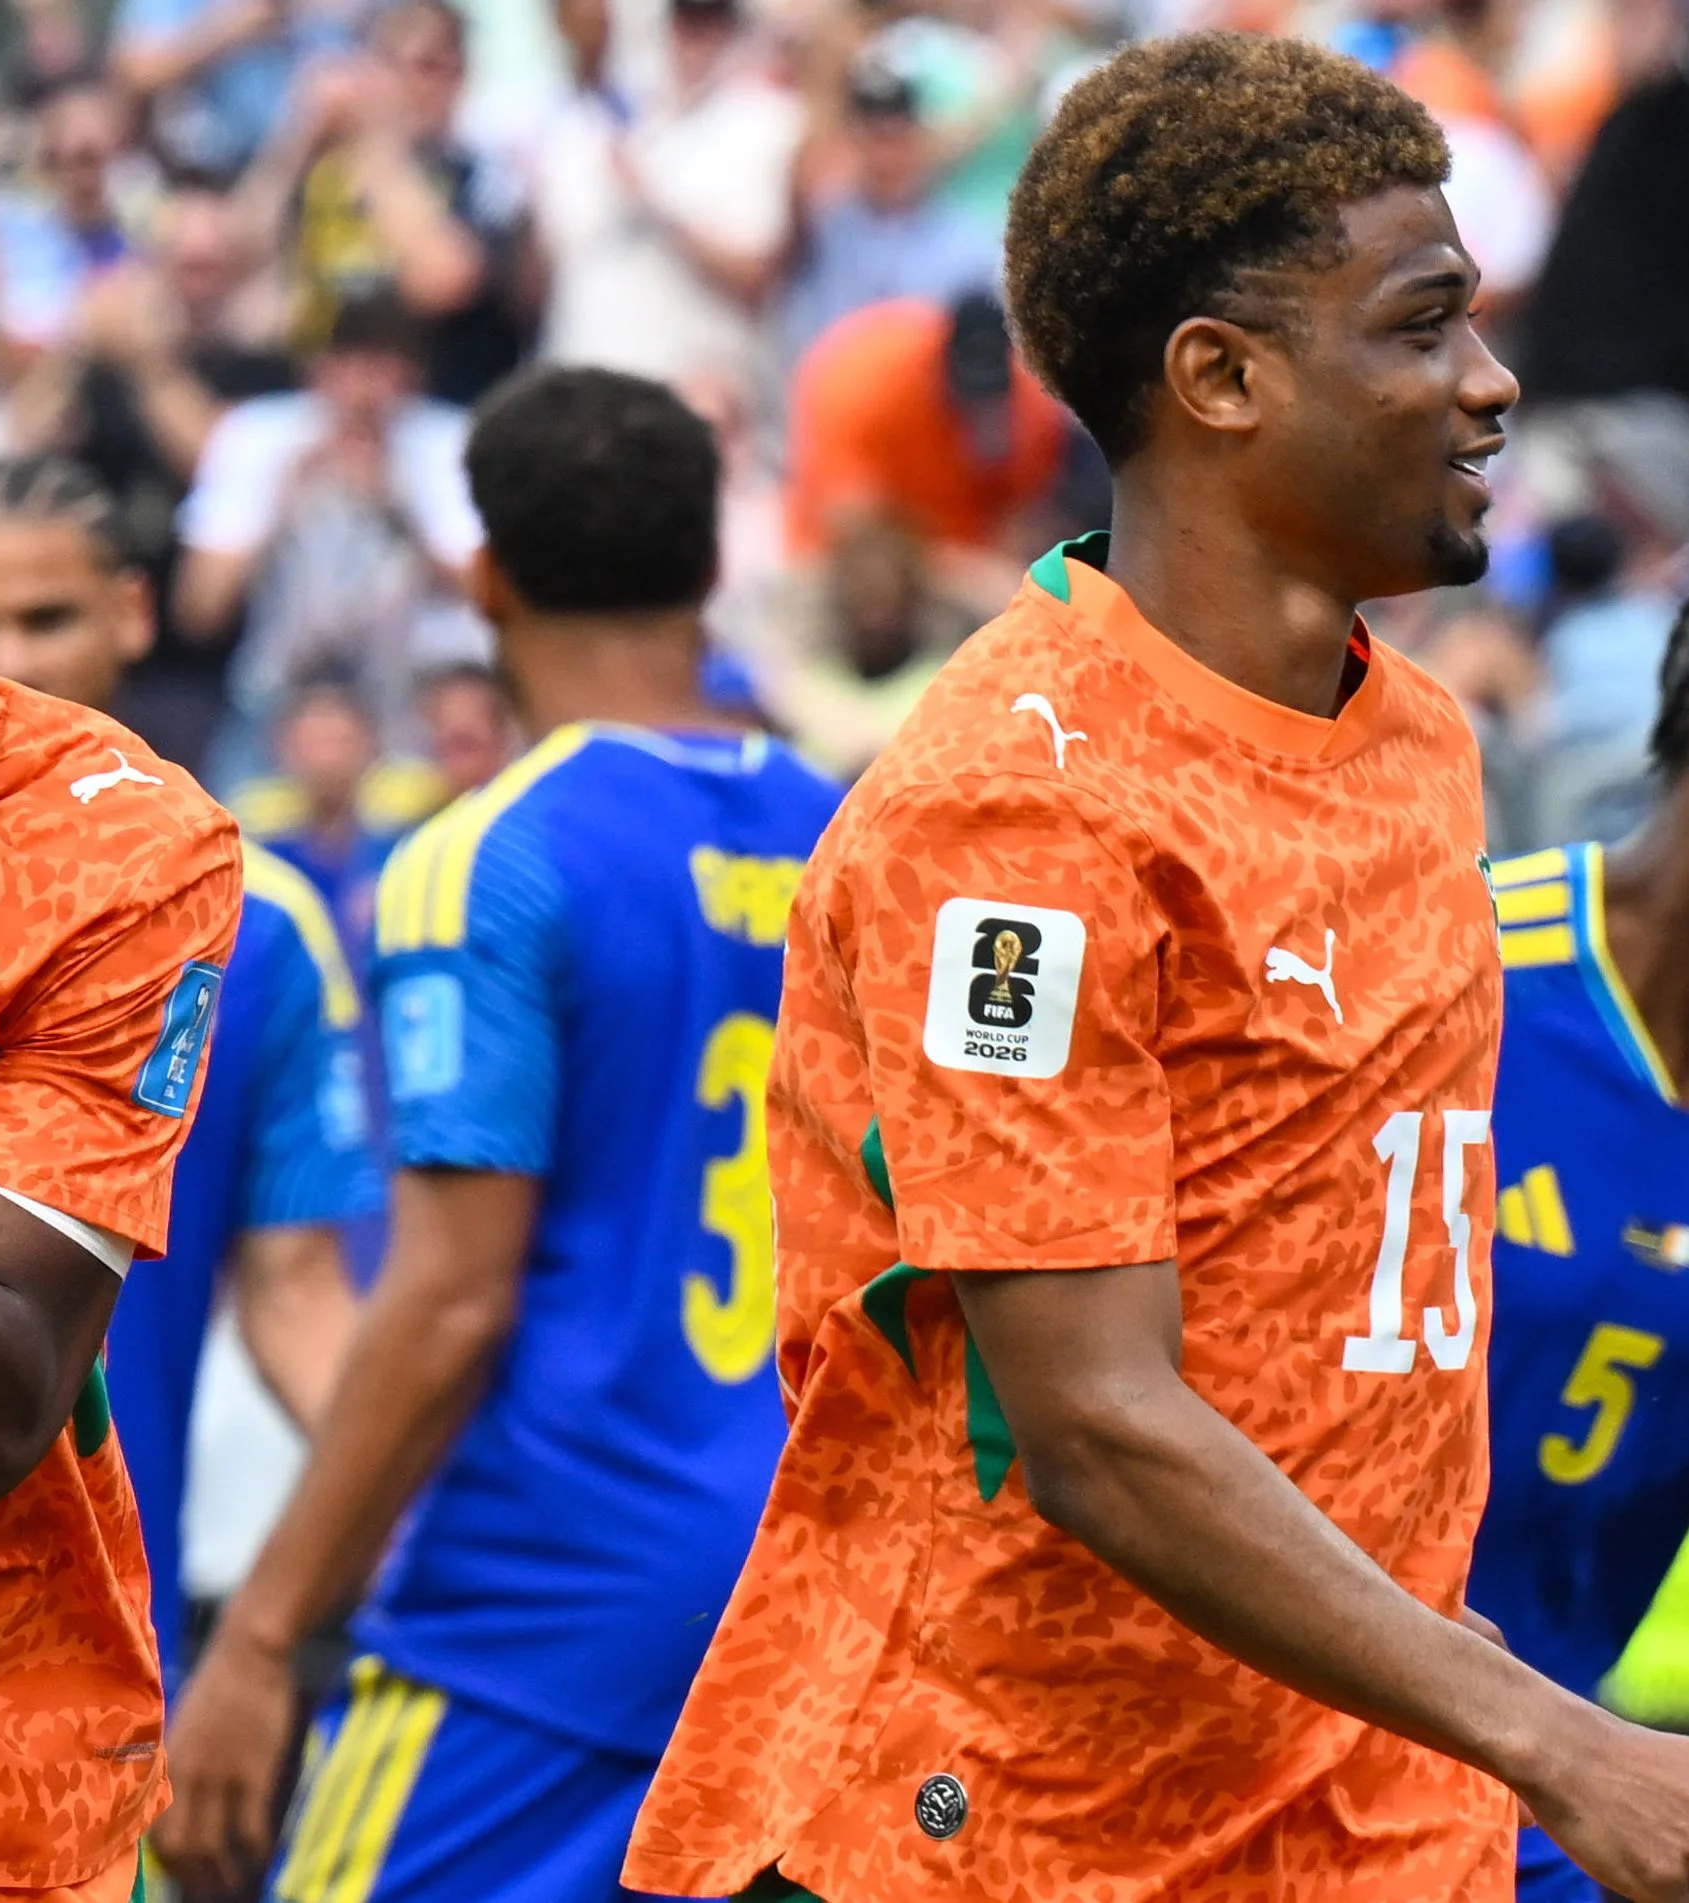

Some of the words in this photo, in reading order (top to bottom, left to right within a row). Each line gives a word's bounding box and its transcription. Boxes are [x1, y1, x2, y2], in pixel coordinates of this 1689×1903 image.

[964, 1041, 1027, 1061] 2026
[966, 1029, 1004, 1042] WORLD
[1007, 1034, 1029, 1044] CUP
[983, 1003, 1014, 1020] FIFA
[681, 1012, 776, 1384] 3
[1342, 1109, 1492, 1373] 15
[1538, 1322, 1664, 1484] 5
